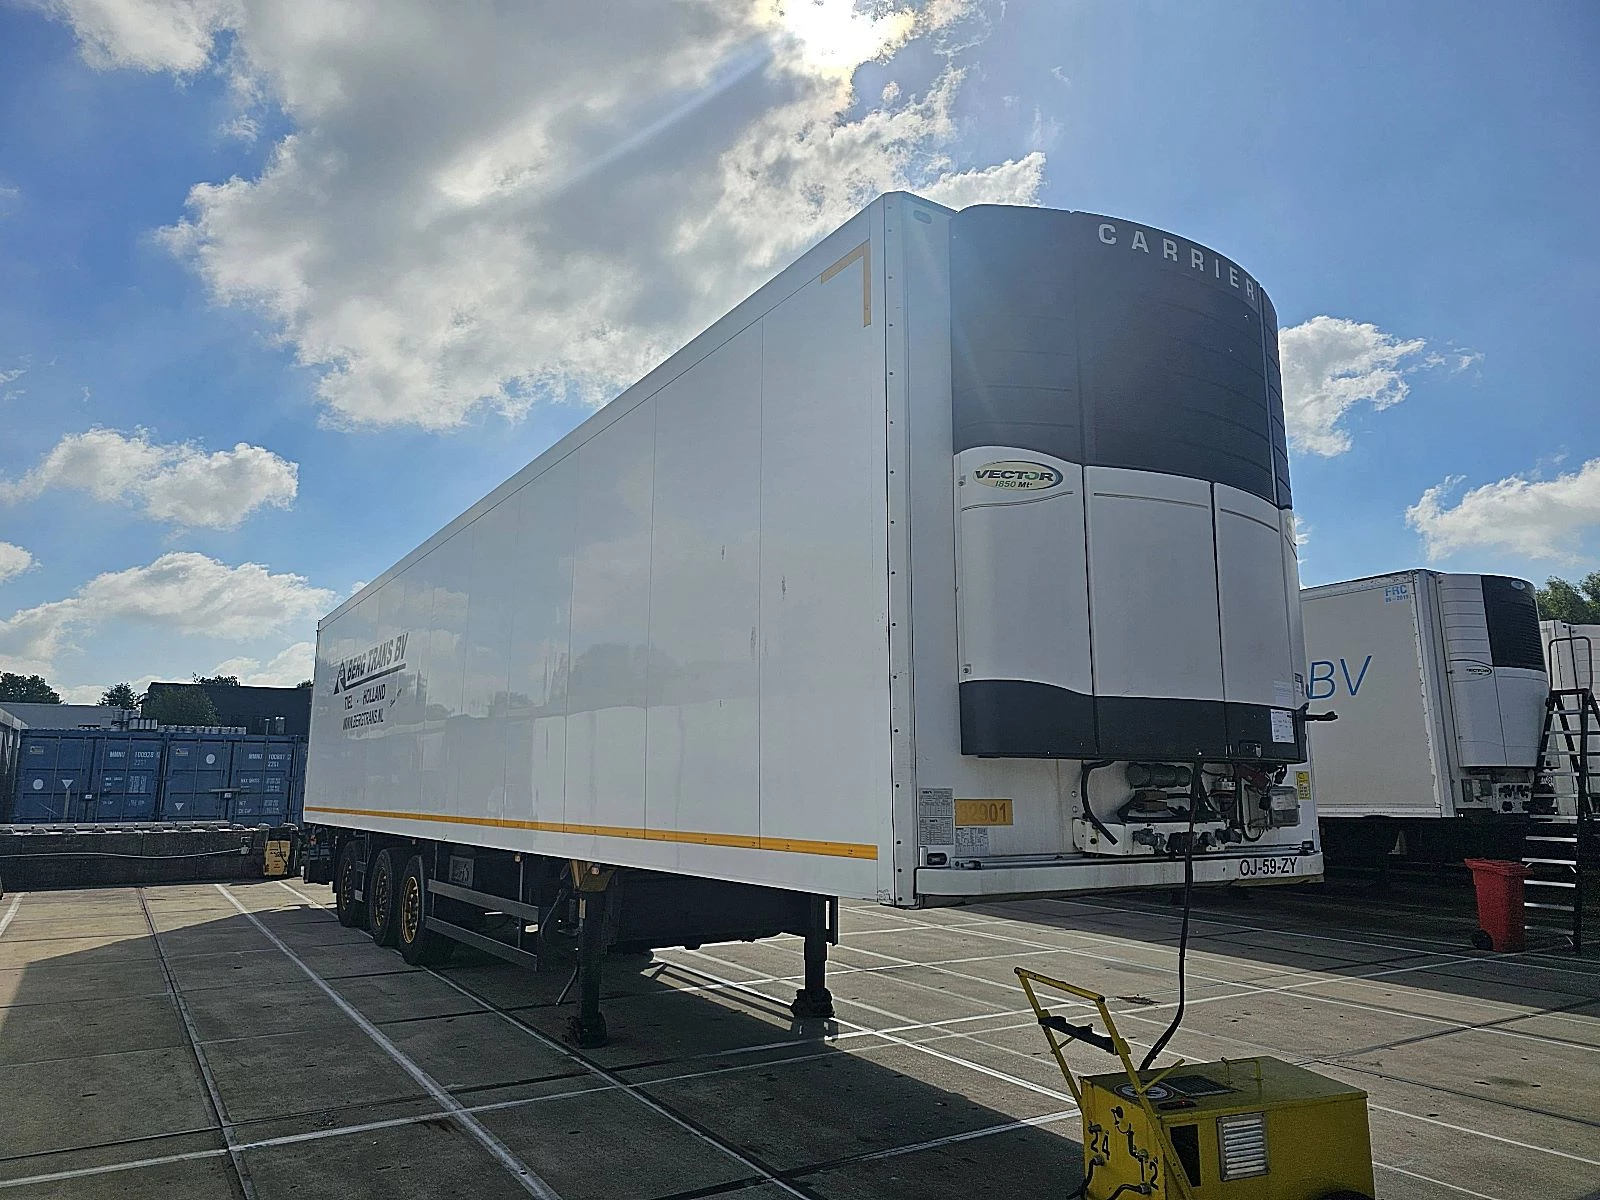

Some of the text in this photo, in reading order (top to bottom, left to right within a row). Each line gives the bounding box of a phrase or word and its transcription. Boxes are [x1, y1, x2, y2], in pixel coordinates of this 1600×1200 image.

[1098, 222, 1256, 301] CARRIER
[975, 469, 1054, 482] VECTOR
[1384, 585, 1407, 596] FRC
[346, 652, 367, 682] BERG
[367, 639, 394, 673] TRANS
[394, 632, 409, 662] BV
[1308, 655, 1373, 700] BV
[362, 683, 386, 705] HOLLAND
[1240, 857, 1298, 876] OJ-59-ZY
